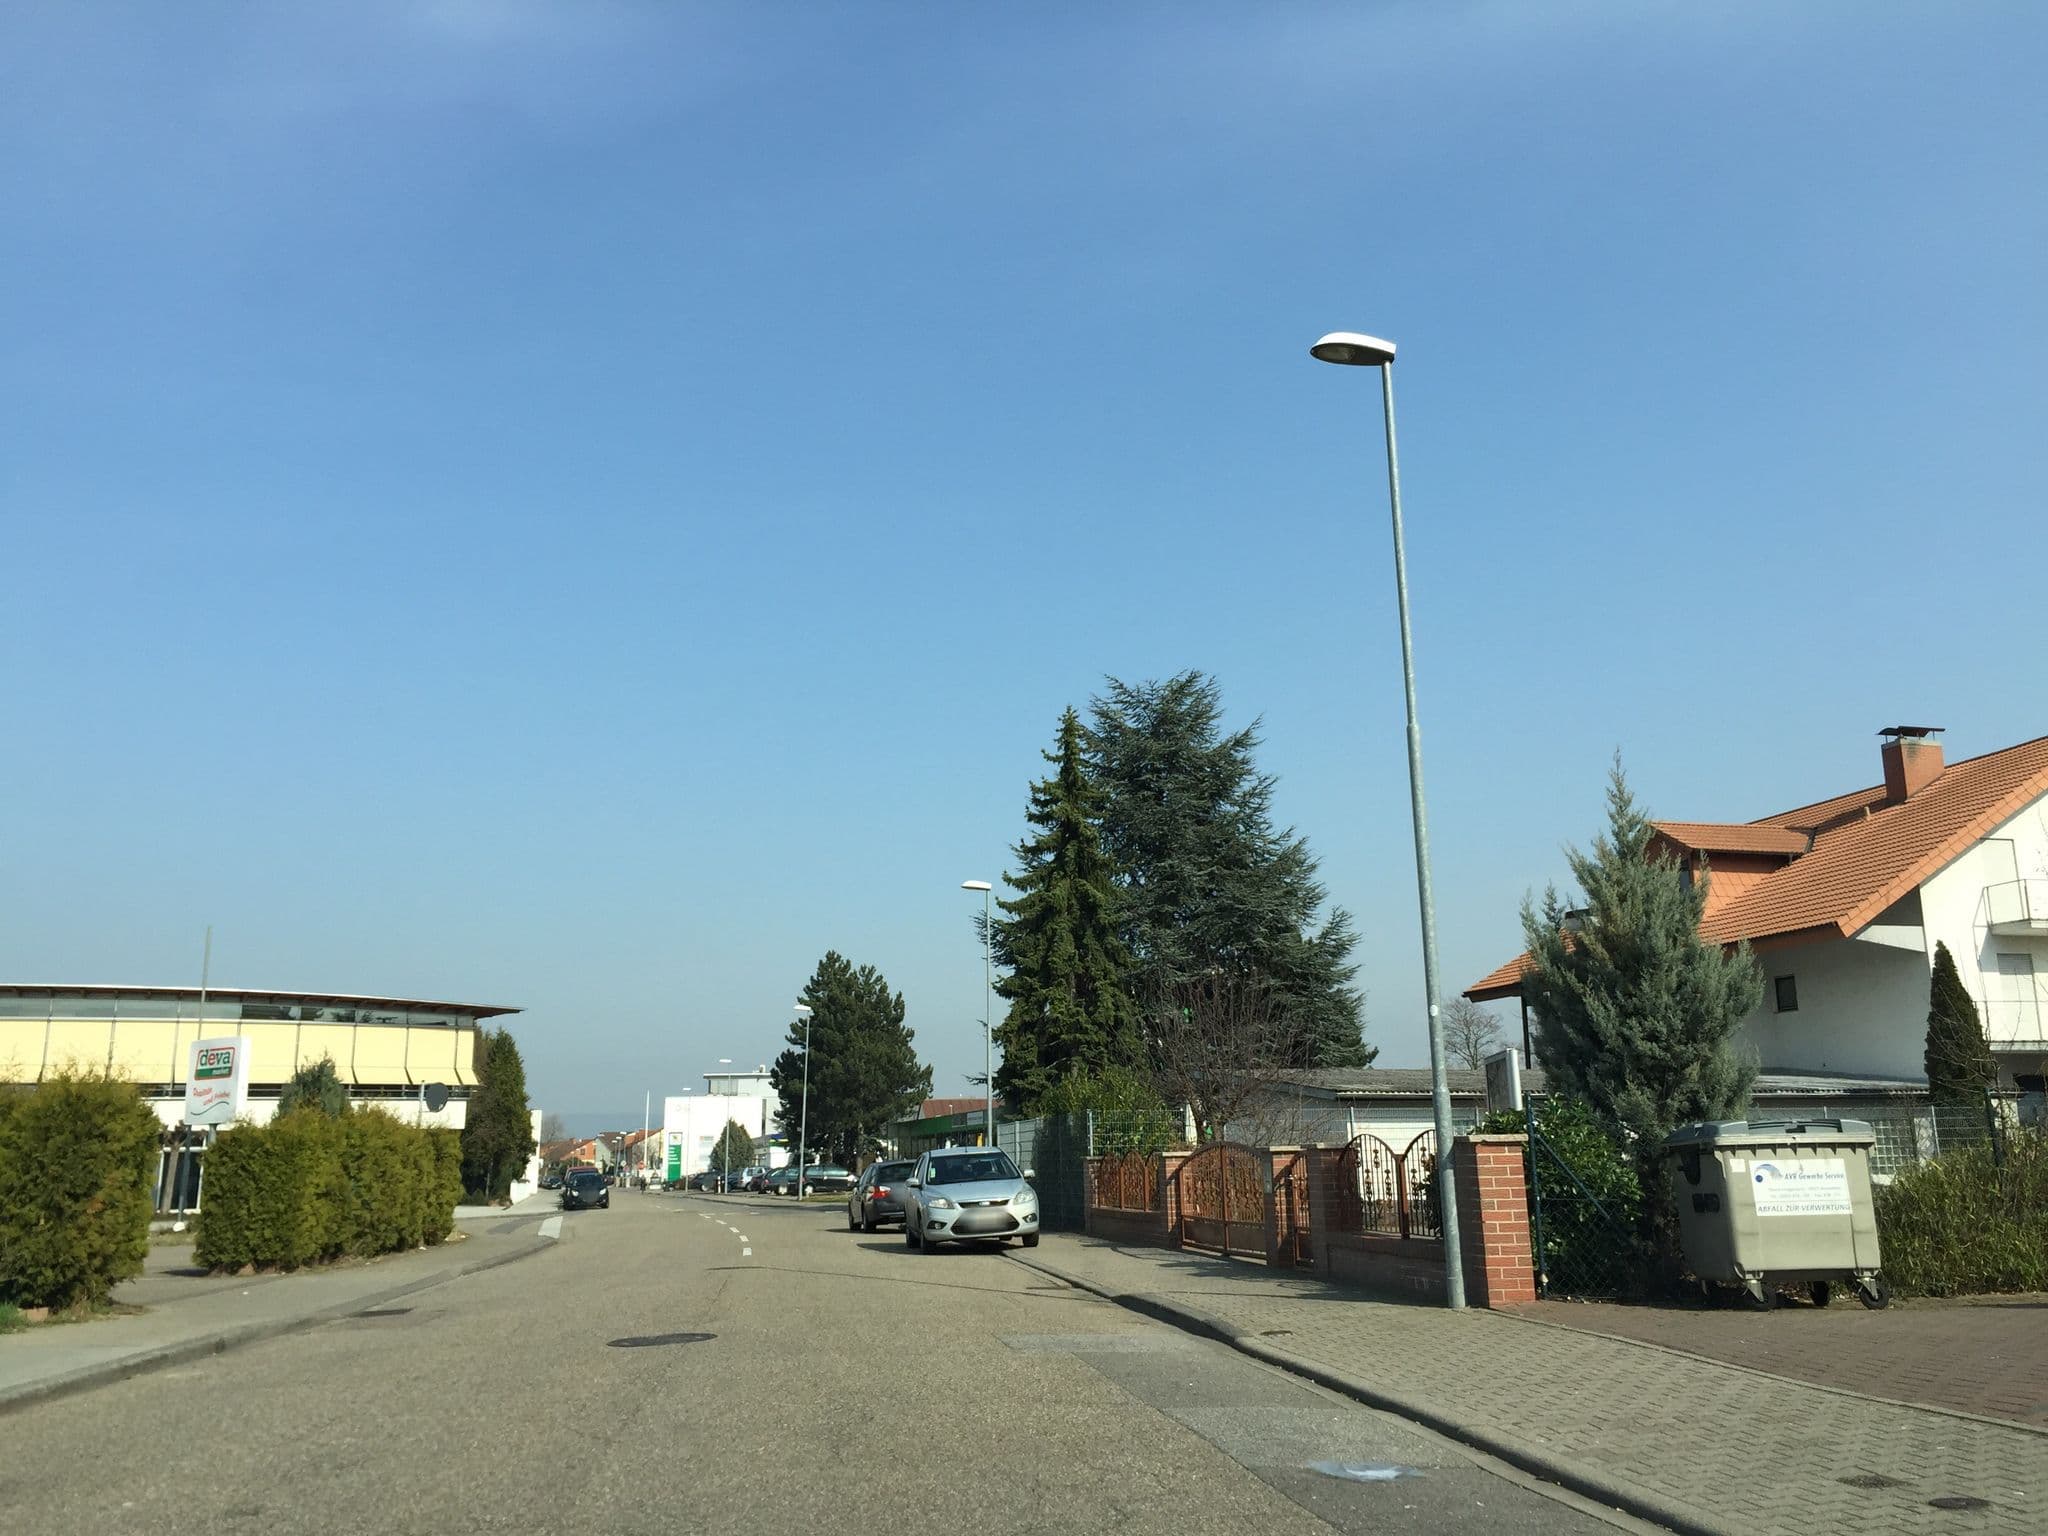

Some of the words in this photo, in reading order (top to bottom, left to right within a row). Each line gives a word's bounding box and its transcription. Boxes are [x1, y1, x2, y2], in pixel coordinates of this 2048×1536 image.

[199, 1049, 231, 1066] deva
[1799, 1172, 1824, 1180] Gewerbe
[1758, 1204, 1783, 1213] ABFALL
[1785, 1204, 1799, 1213] ZUR
[1800, 1203, 1851, 1212] VERWERTUNG
